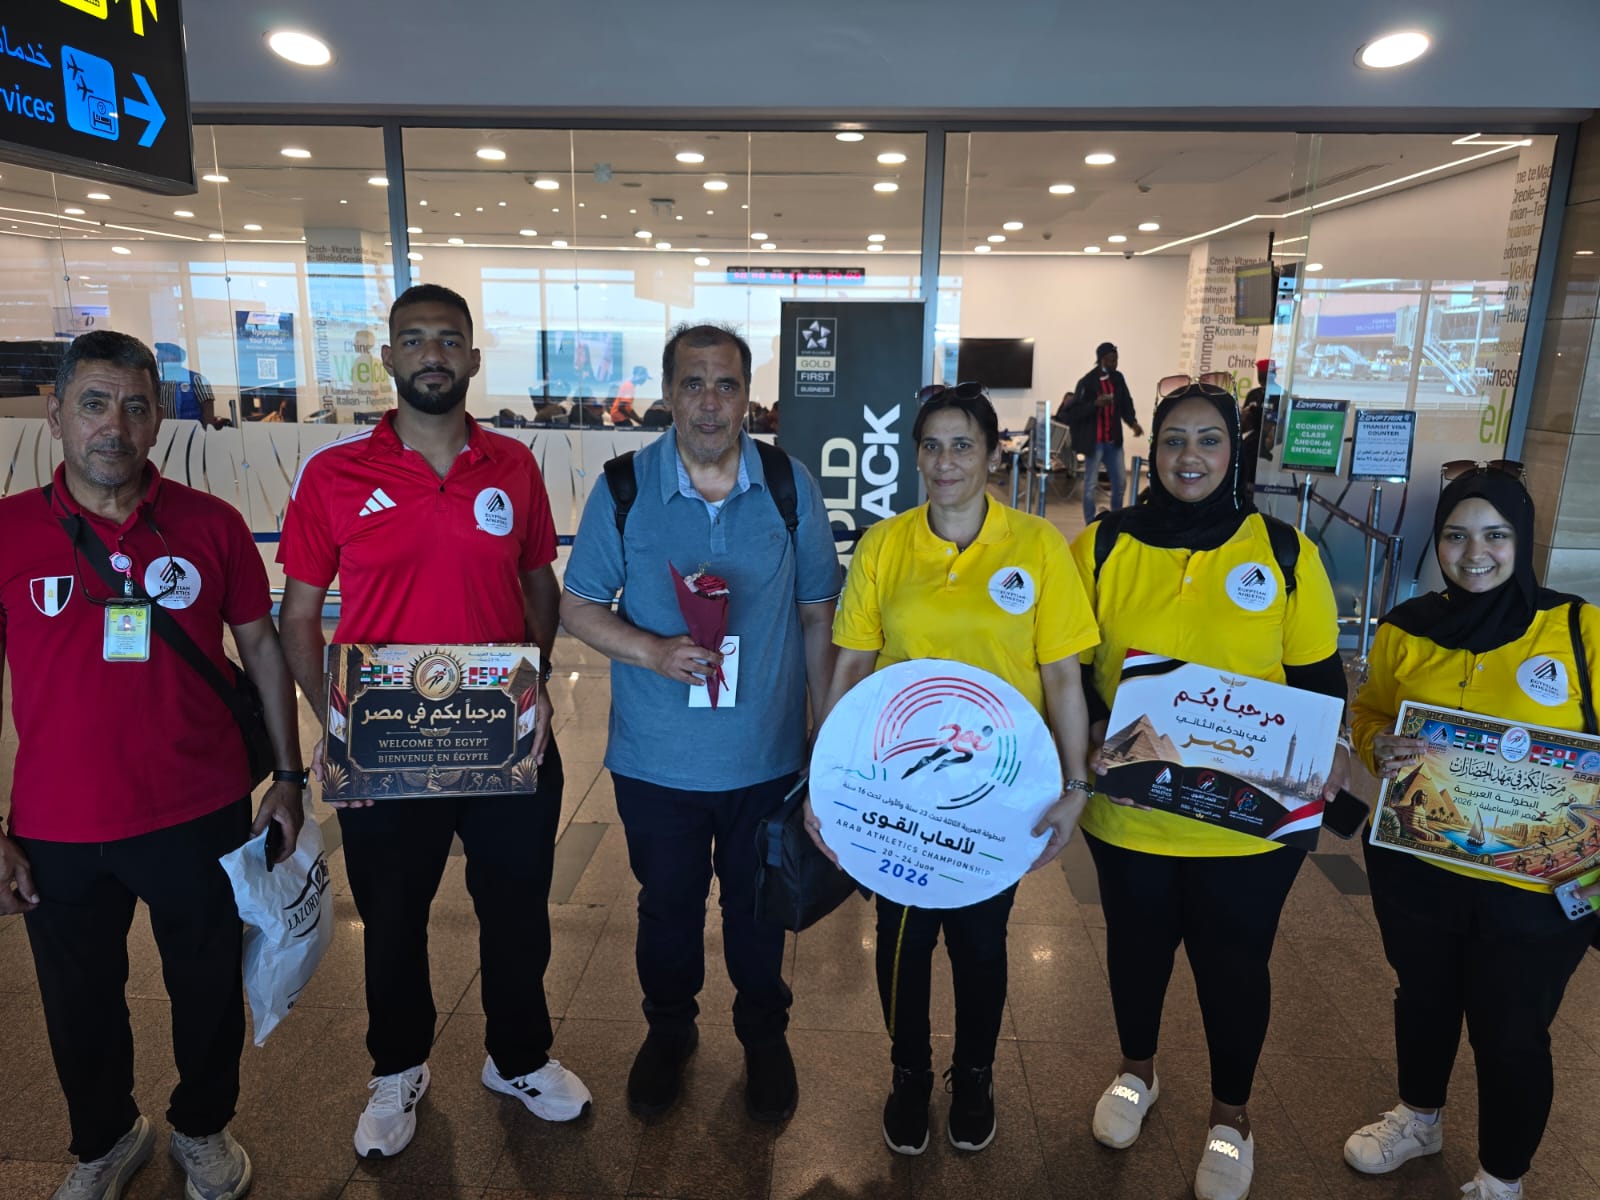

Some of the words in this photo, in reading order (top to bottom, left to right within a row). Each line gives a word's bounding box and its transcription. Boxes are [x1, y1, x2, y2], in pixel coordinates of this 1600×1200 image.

[0, 25, 52, 69] خدما
[801, 359, 831, 369] GOLD
[801, 372, 830, 381] FIRST
[1295, 423, 1334, 431] ECONOMY
[1291, 447, 1332, 455] ENTRANCE
[1294, 438, 1332, 447] CHECK-IN
[1173, 686, 1219, 712] بكم
[361, 707, 404, 725] مصر
[407, 702, 427, 729] في
[430, 703, 462, 726] بكم
[1215, 725, 1246, 738] بلدكم
[1246, 733, 1268, 743] في
[378, 739, 433, 748] WELCOME
[436, 738, 451, 747] TO
[455, 737, 489, 747] EGYPT
[1179, 733, 1255, 759] مصر
[378, 753, 434, 763] BIENVENUE
[437, 753, 450, 761] EN
[453, 752, 489, 761] ÉGYPTE
[858, 786, 866, 795] 16
[1453, 796, 1472, 807] 2026
[861, 810, 920, 838] القوى
[836, 818, 862, 833] ARAB
[866, 829, 919, 854] ATHLETICS
[921, 849, 992, 877] CHAMPIONSHIP
[882, 847, 893, 857] 20
[901, 855, 912, 865] 24
[914, 860, 935, 872] June
[878, 858, 929, 887] 2026
[1112, 1085, 1140, 1105] HOKA
[1209, 1139, 1239, 1160] HOKA
